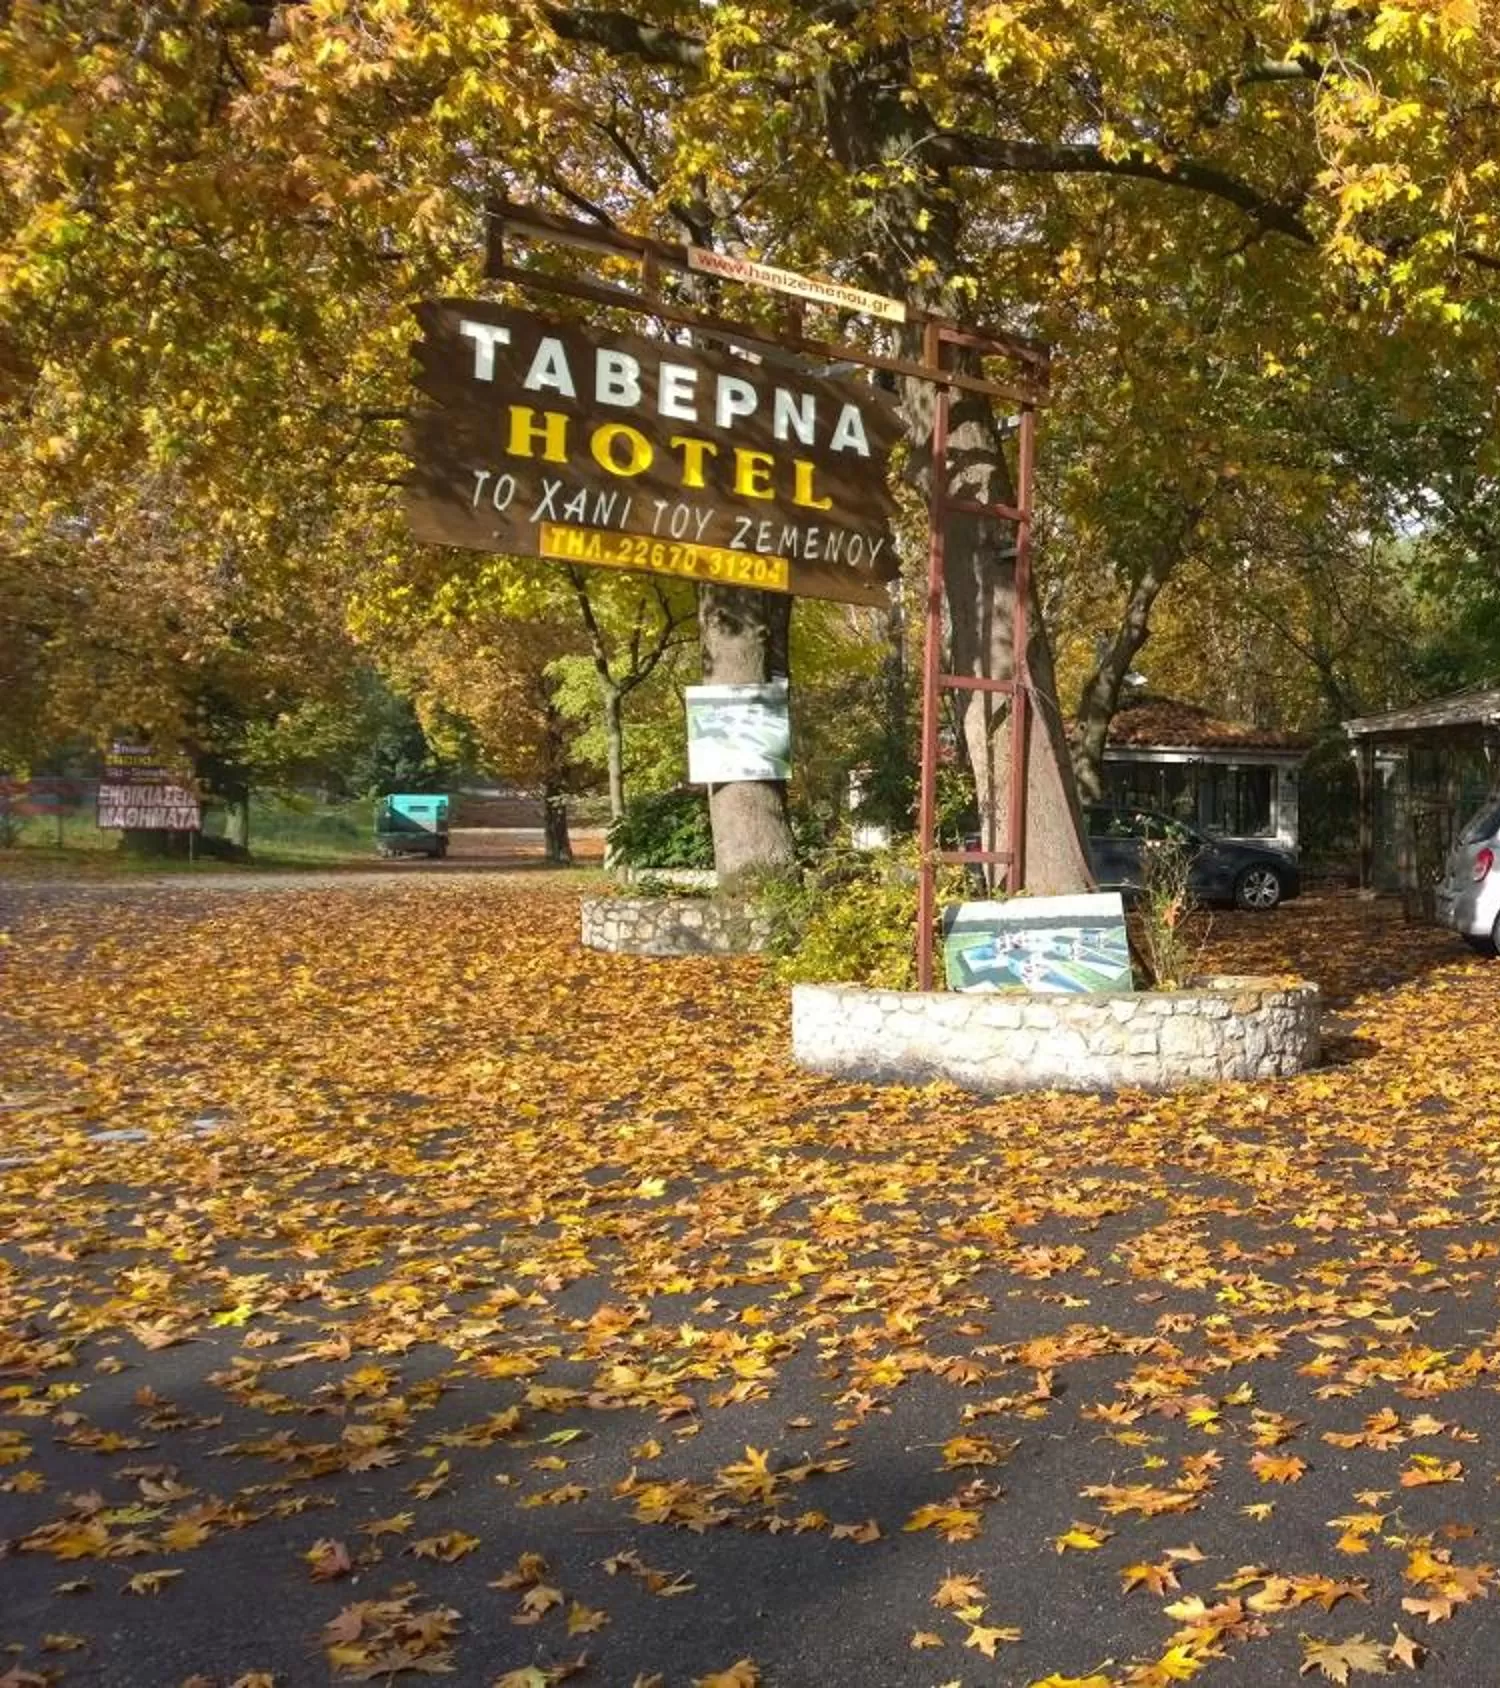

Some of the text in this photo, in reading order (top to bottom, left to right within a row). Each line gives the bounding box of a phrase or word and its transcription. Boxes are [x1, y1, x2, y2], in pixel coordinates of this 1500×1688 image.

[697, 252, 890, 313] www.hanizemenou.gr
[460, 319, 871, 458] ΤΑΒΕΡΝΑ
[506, 405, 833, 511] HOTEL
[471, 470, 888, 569] ΤΟ ΧΑΝΙ ΤΟΥ ΖΕΜΕΝΟΥ
[709, 550, 783, 582] 31204
